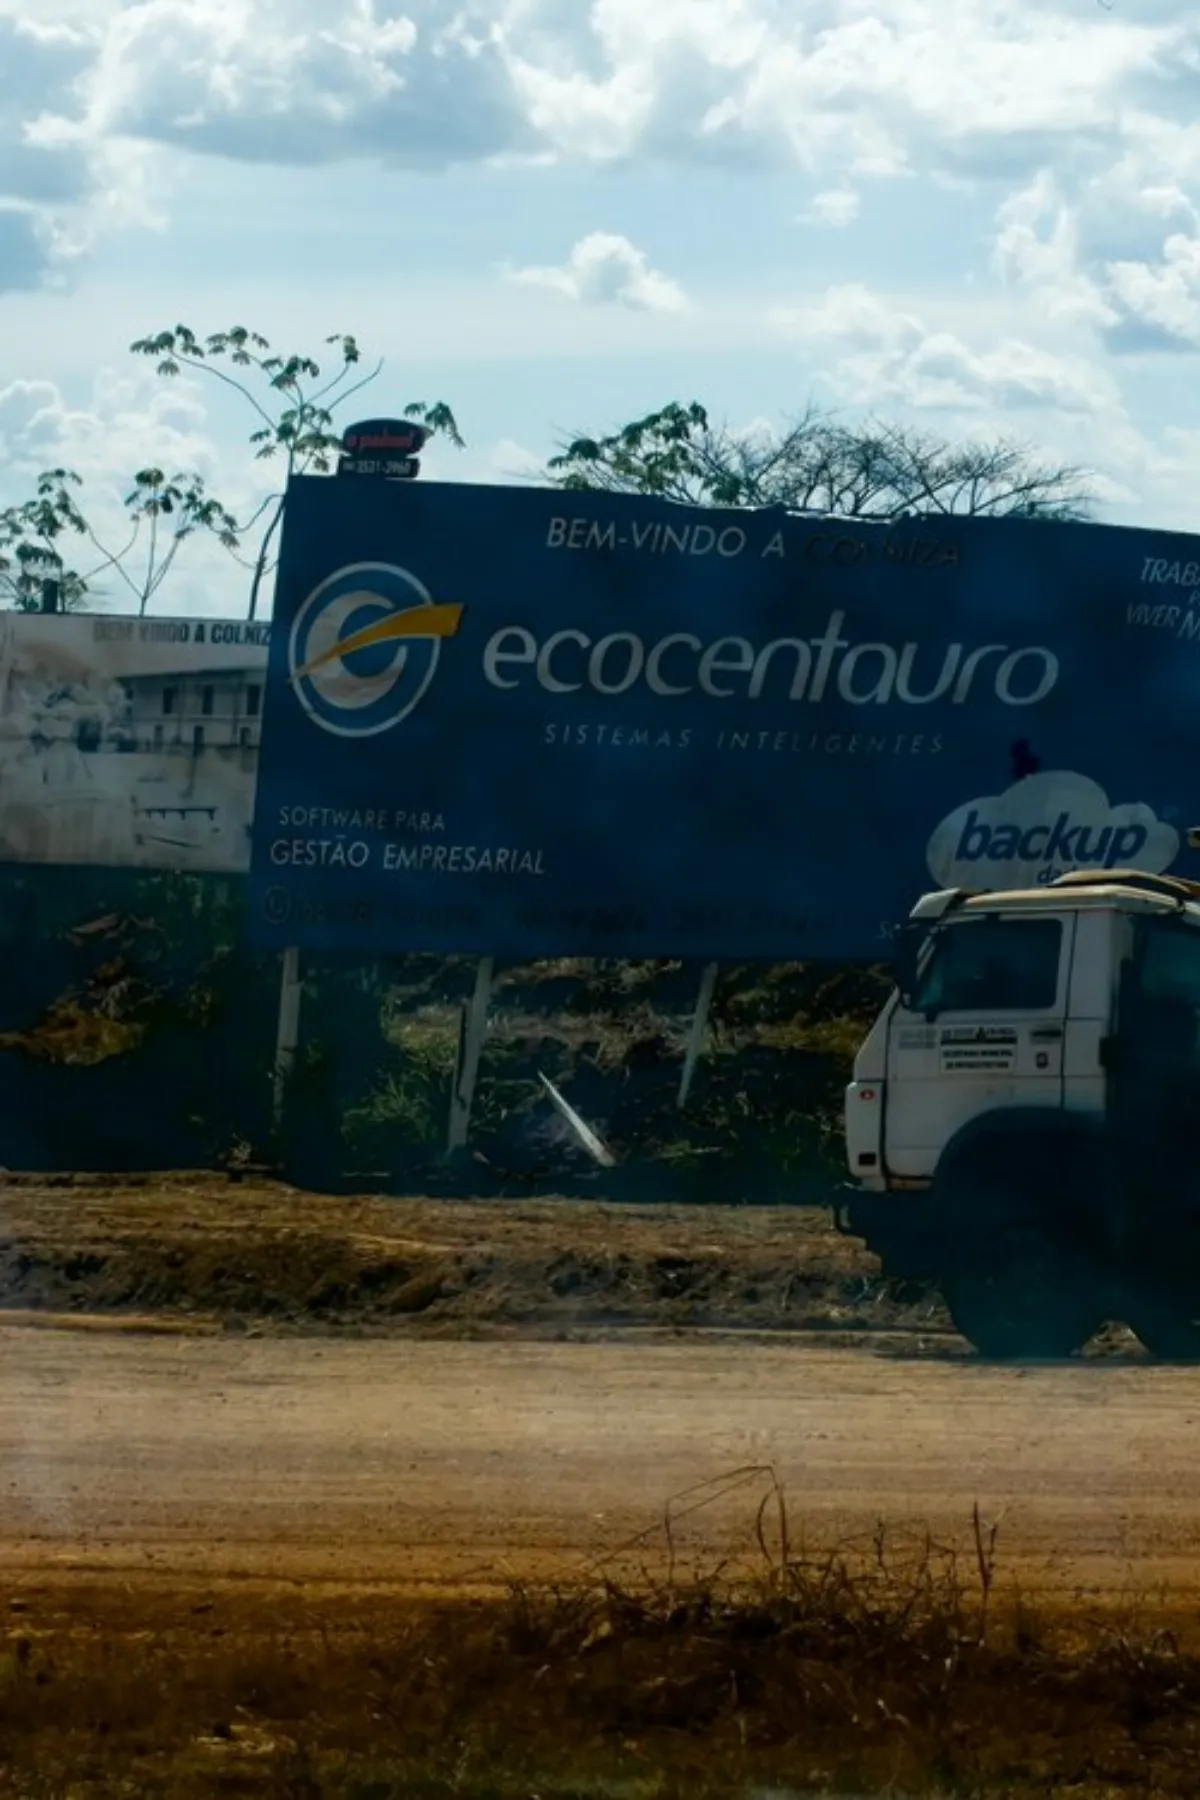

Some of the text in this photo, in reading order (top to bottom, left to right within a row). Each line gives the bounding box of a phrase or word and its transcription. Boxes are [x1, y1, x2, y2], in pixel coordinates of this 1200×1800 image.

[546, 518, 746, 557] BEM-VINDO
[760, 530, 786, 558] A
[1126, 601, 1182, 629] VIVER
[482, 608, 1060, 705] ecocentauro
[543, 723, 944, 755] SISTEMAS INTELIGENTES
[279, 805, 446, 833] SOFTWARE PARA
[270, 833, 546, 875] GESTÃO EMPRESARIAL
[956, 810, 1147, 869] backup
